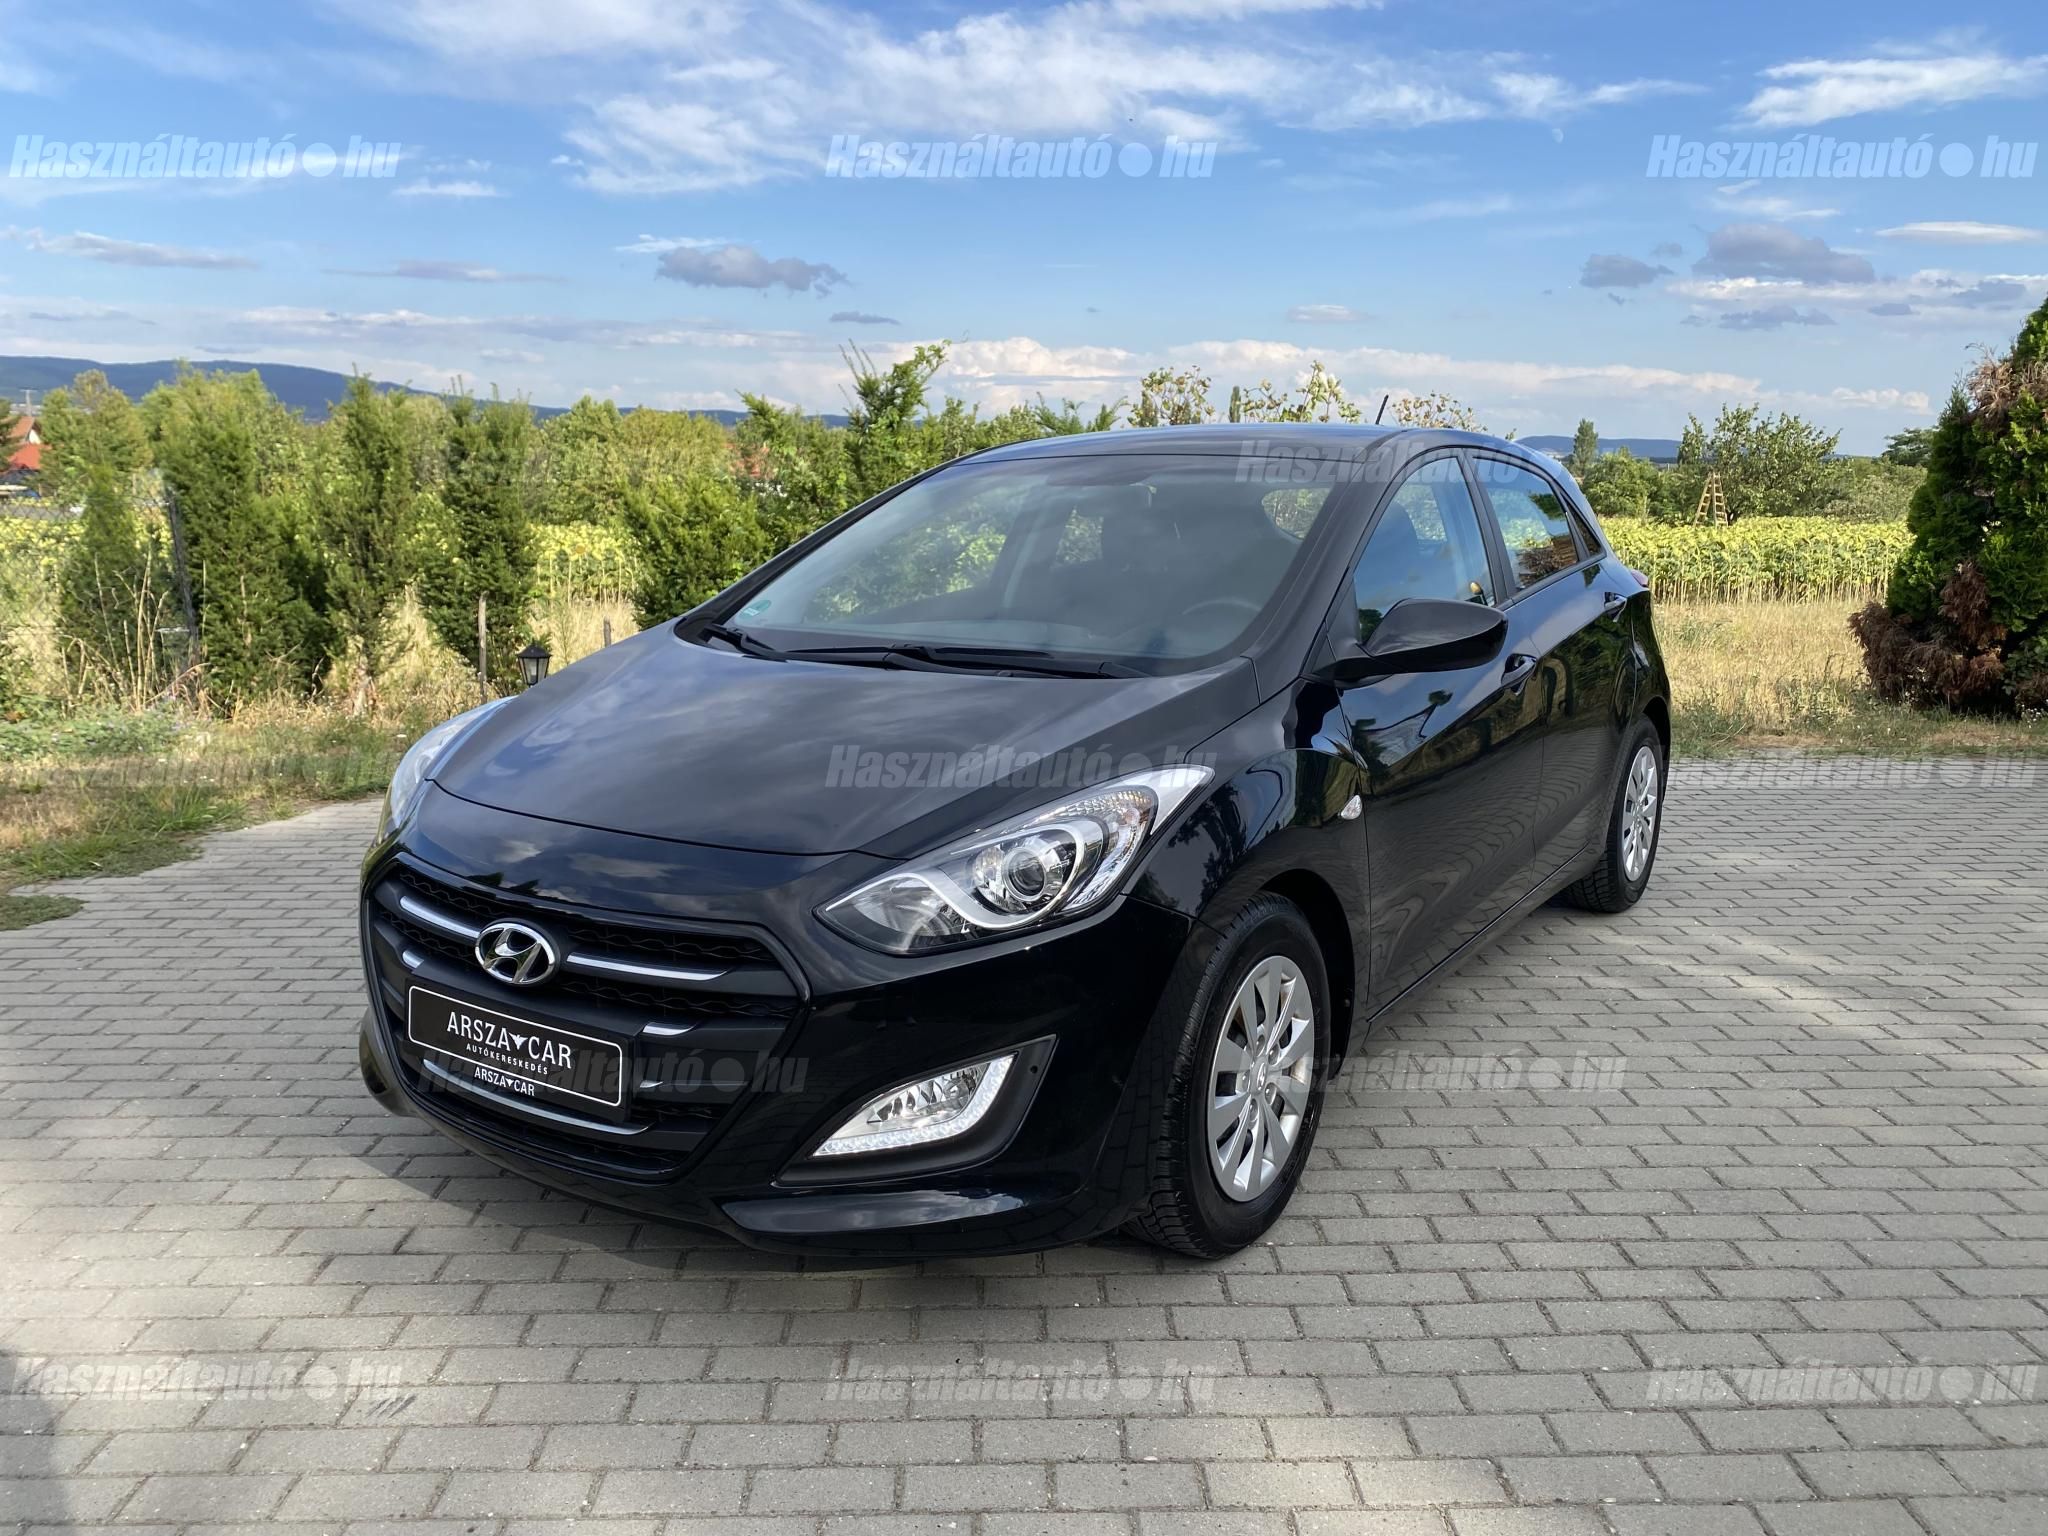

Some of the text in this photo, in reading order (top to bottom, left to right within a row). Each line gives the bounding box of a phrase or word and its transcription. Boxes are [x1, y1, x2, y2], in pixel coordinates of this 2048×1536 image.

[446, 1011, 572, 1069] ARSZA CAR
[466, 1042, 549, 1075] AUTÓKERESKEDÉS
[474, 1066, 535, 1097] ARSZA CAR
